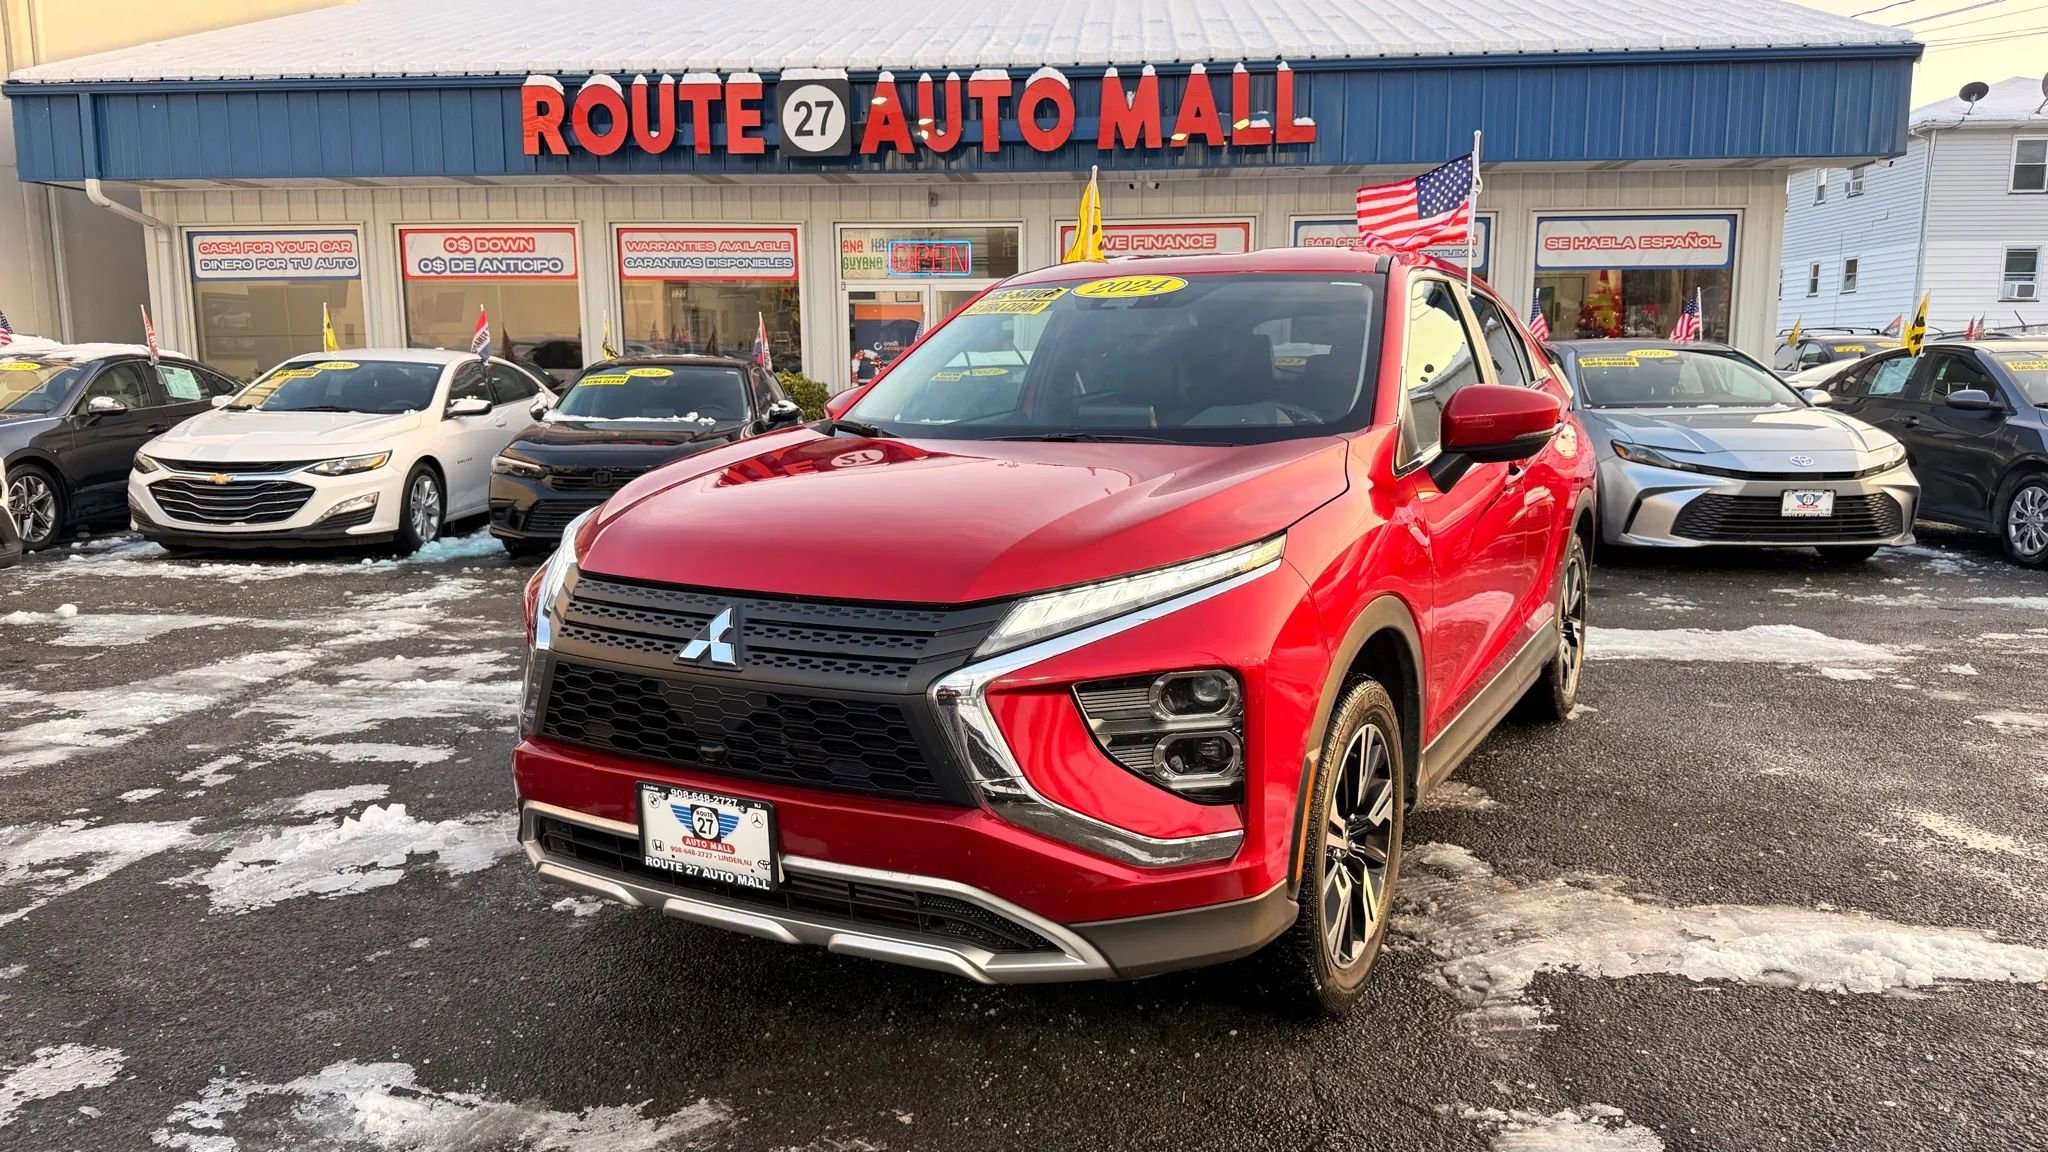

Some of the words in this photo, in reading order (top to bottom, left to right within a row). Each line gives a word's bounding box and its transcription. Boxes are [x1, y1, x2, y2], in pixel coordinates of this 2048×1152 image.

[521, 82, 766, 156] ROUTE
[792, 100, 835, 138] 27
[859, 78, 1076, 155] AUTO
[1097, 69, 1317, 150] MALL
[199, 242, 241, 255] CASH
[243, 241, 274, 254] FOR
[275, 241, 318, 254] YOUR
[319, 240, 352, 253] CAR
[475, 237, 535, 252] DOWN
[625, 240, 715, 252] WARRANTIES
[718, 240, 791, 252] AVAILABLE
[1101, 235, 1128, 250] WE
[1132, 233, 1216, 250] FINANCE
[1304, 237, 1334, 247] BAD
[1335, 237, 1365, 247] CRE
[1545, 236, 1570, 249] SE
[1573, 235, 1635, 249] HABLA
[1638, 232, 1721, 249] ESPAÑOL
[200, 258, 253, 271] DINERO
[256, 258, 287, 270] POR
[289, 258, 312, 270] TU
[315, 258, 357, 269] AUTO
[449, 258, 476, 273] DE
[478, 258, 563, 273] ANTICIPO
[624, 257, 702, 269] GARANTIAS
[705, 257, 793, 269] DISPONIBLES
[842, 256, 883, 270] GUYANA
[892, 244, 969, 273] OPEN
[1090, 279, 1172, 294] 2024
[670, 788, 738, 807] 908-648-2727
[695, 810, 714, 819] ROUTE
[697, 818, 714, 836] 27
[685, 838, 708, 849] AUTO
[710, 842, 734, 853] MALL
[644, 856, 683, 873] ROUTE
[686, 864, 700, 876] 27
[702, 868, 734, 883] AUTO
[737, 875, 770, 891] MALL
